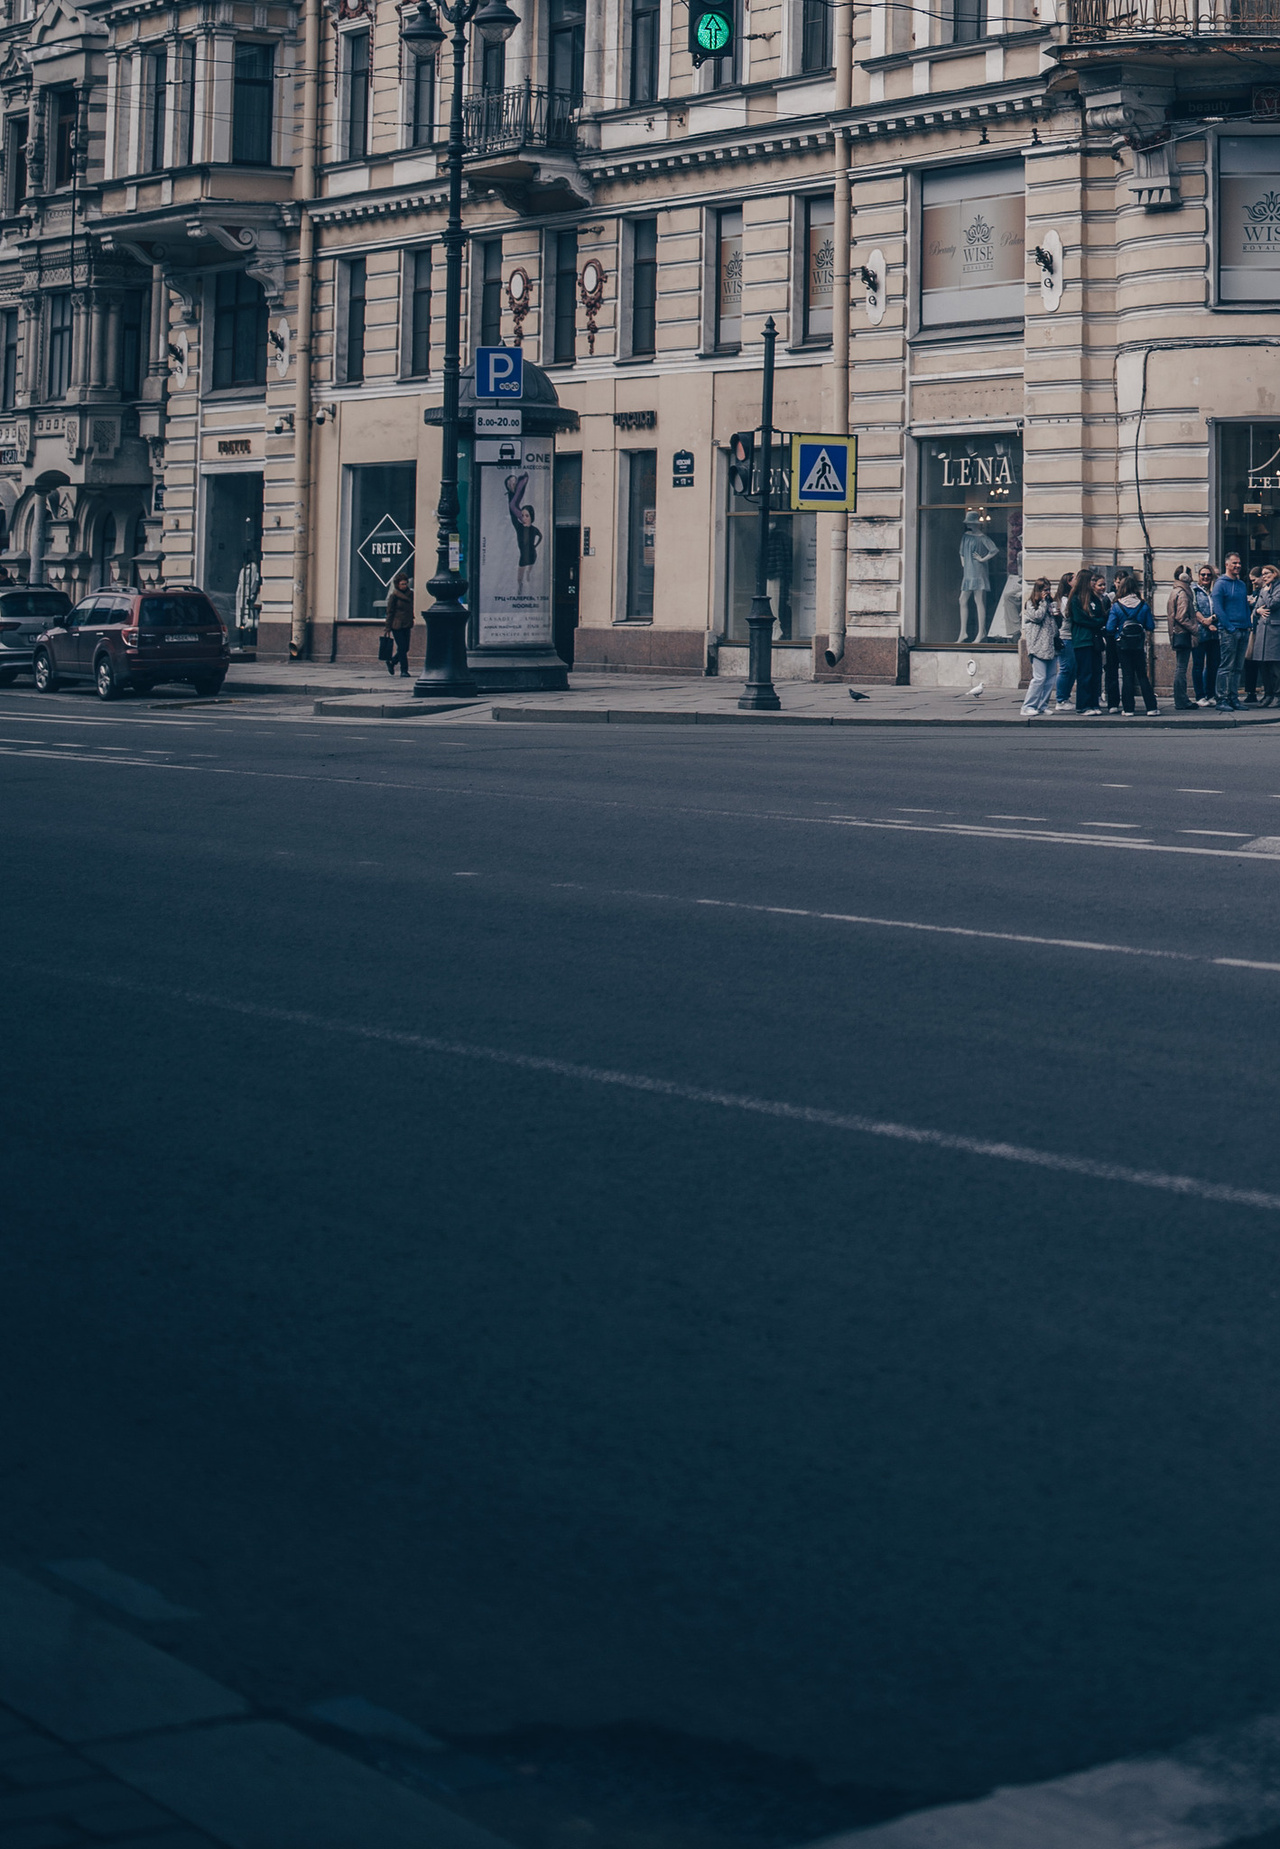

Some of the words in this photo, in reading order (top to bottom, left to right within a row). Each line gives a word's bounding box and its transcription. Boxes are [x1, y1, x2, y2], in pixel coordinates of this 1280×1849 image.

[1188, 102, 1231, 113] beauty
[963, 245, 994, 263] WISE
[813, 270, 835, 285] WIS
[723, 280, 743, 295] WIS
[489, 353, 514, 392] P
[477, 417, 520, 427] 8.00-20.00
[525, 453, 551, 463] ONE
[942, 456, 1013, 486] LENA
[372, 542, 402, 555] FRETTE
